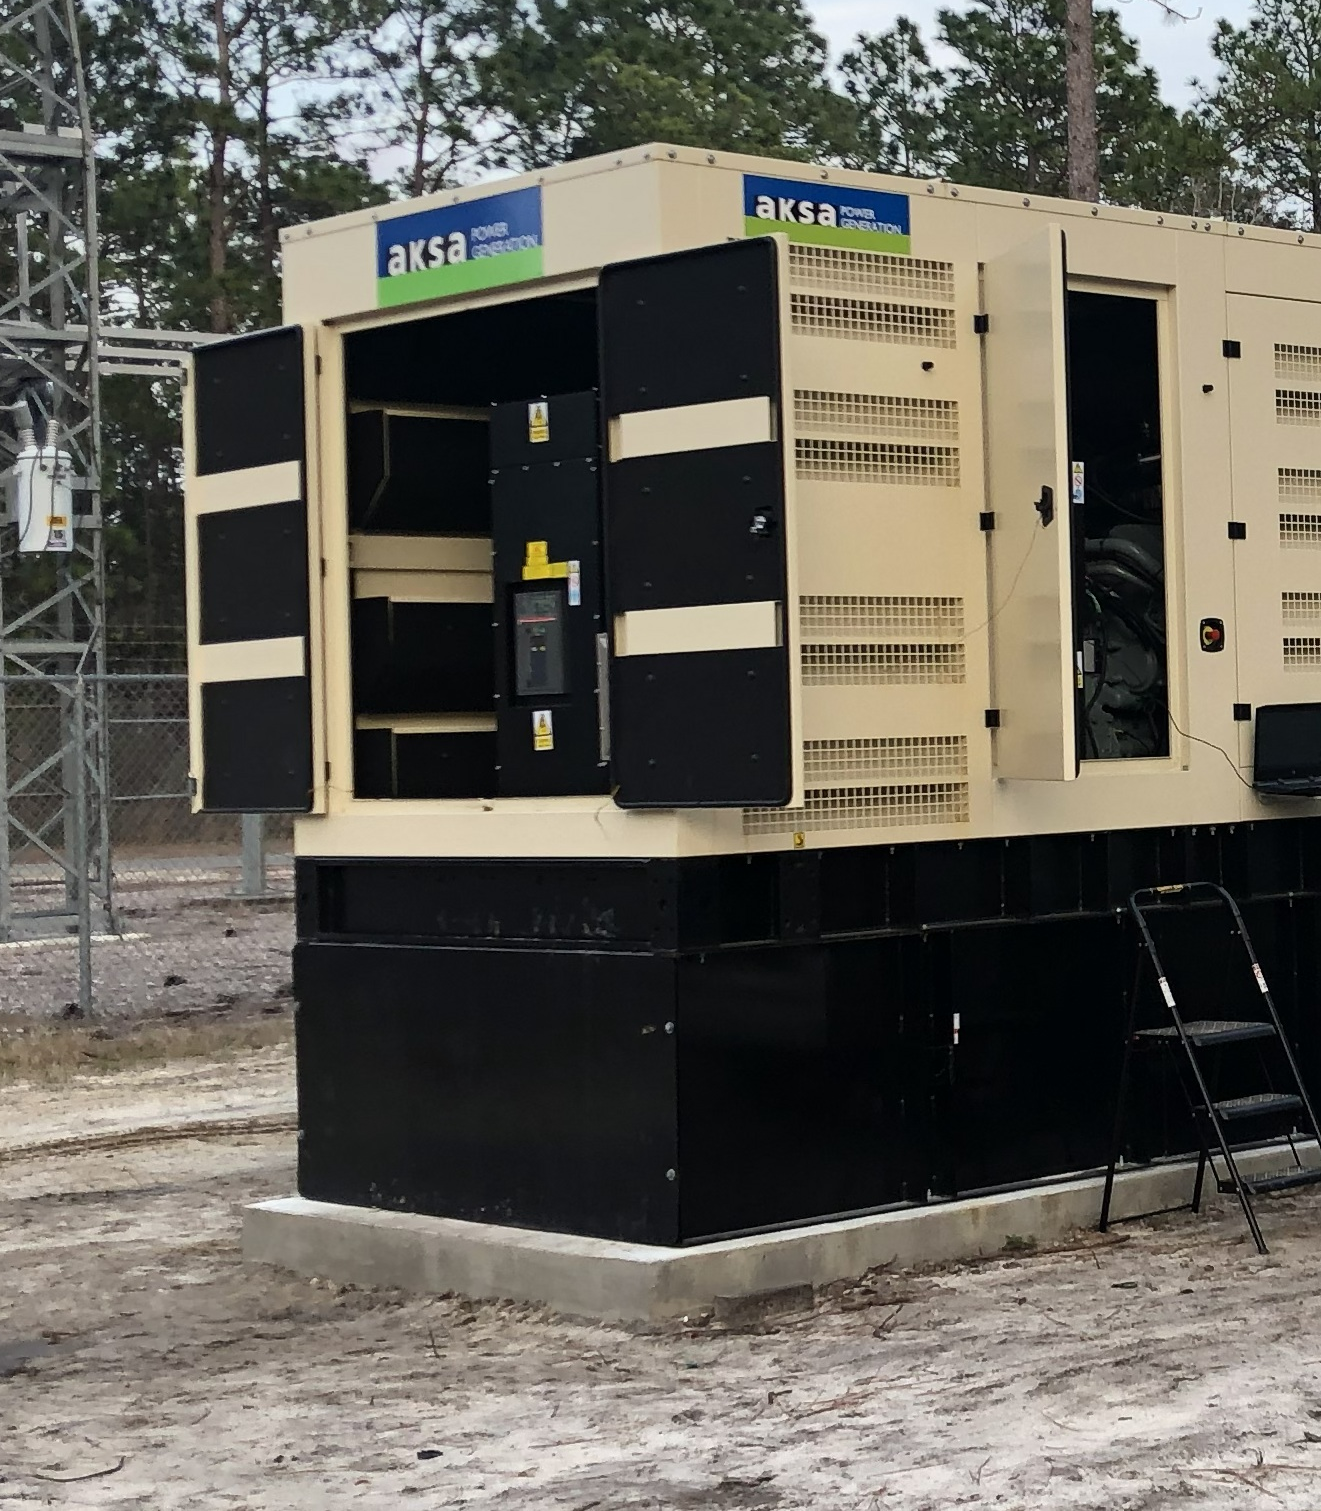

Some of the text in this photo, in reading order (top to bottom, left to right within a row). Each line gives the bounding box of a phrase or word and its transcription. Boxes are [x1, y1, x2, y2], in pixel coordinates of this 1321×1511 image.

[755, 195, 837, 228] aksa
[840, 205, 876, 220] POWER
[470, 222, 509, 241] POWER
[840, 217, 902, 236] GENERATION
[387, 231, 467, 277] aksa
[471, 234, 539, 259] GENERATION
